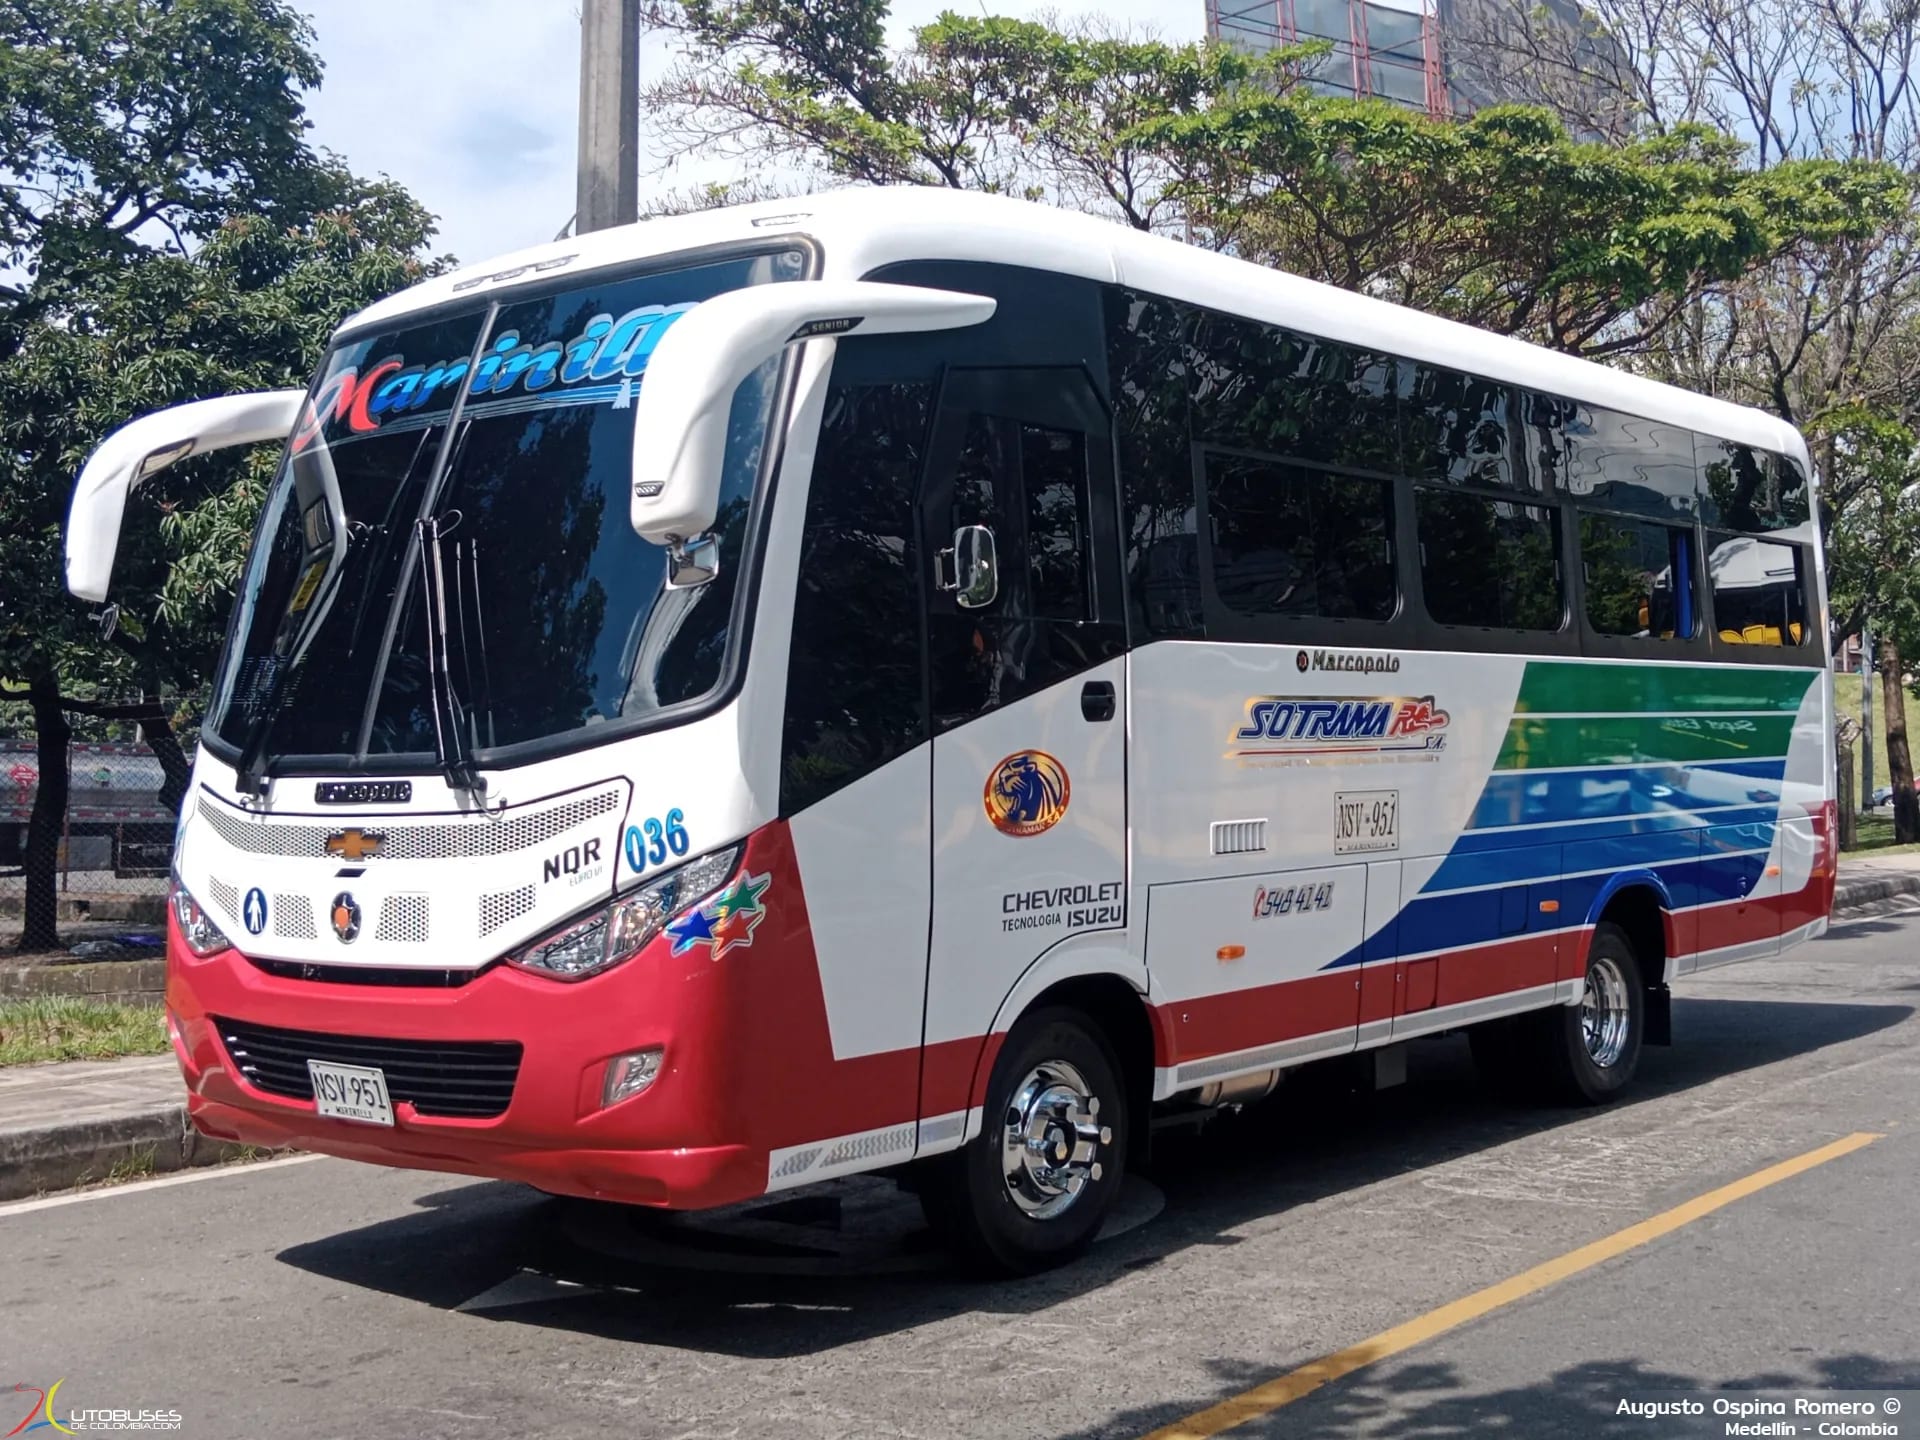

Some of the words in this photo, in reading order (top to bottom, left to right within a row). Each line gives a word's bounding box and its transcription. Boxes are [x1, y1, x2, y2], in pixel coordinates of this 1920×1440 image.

[812, 320, 850, 332] SENIOR
[290, 302, 697, 453] Marinill
[1312, 650, 1400, 675] Marcopolo
[625, 808, 690, 874] 036
[543, 836, 602, 884] NQR
[1002, 882, 1122, 914] CHEVROLET
[1002, 913, 1062, 932] TECNOLOGIA
[1067, 905, 1121, 928] ISUZU
